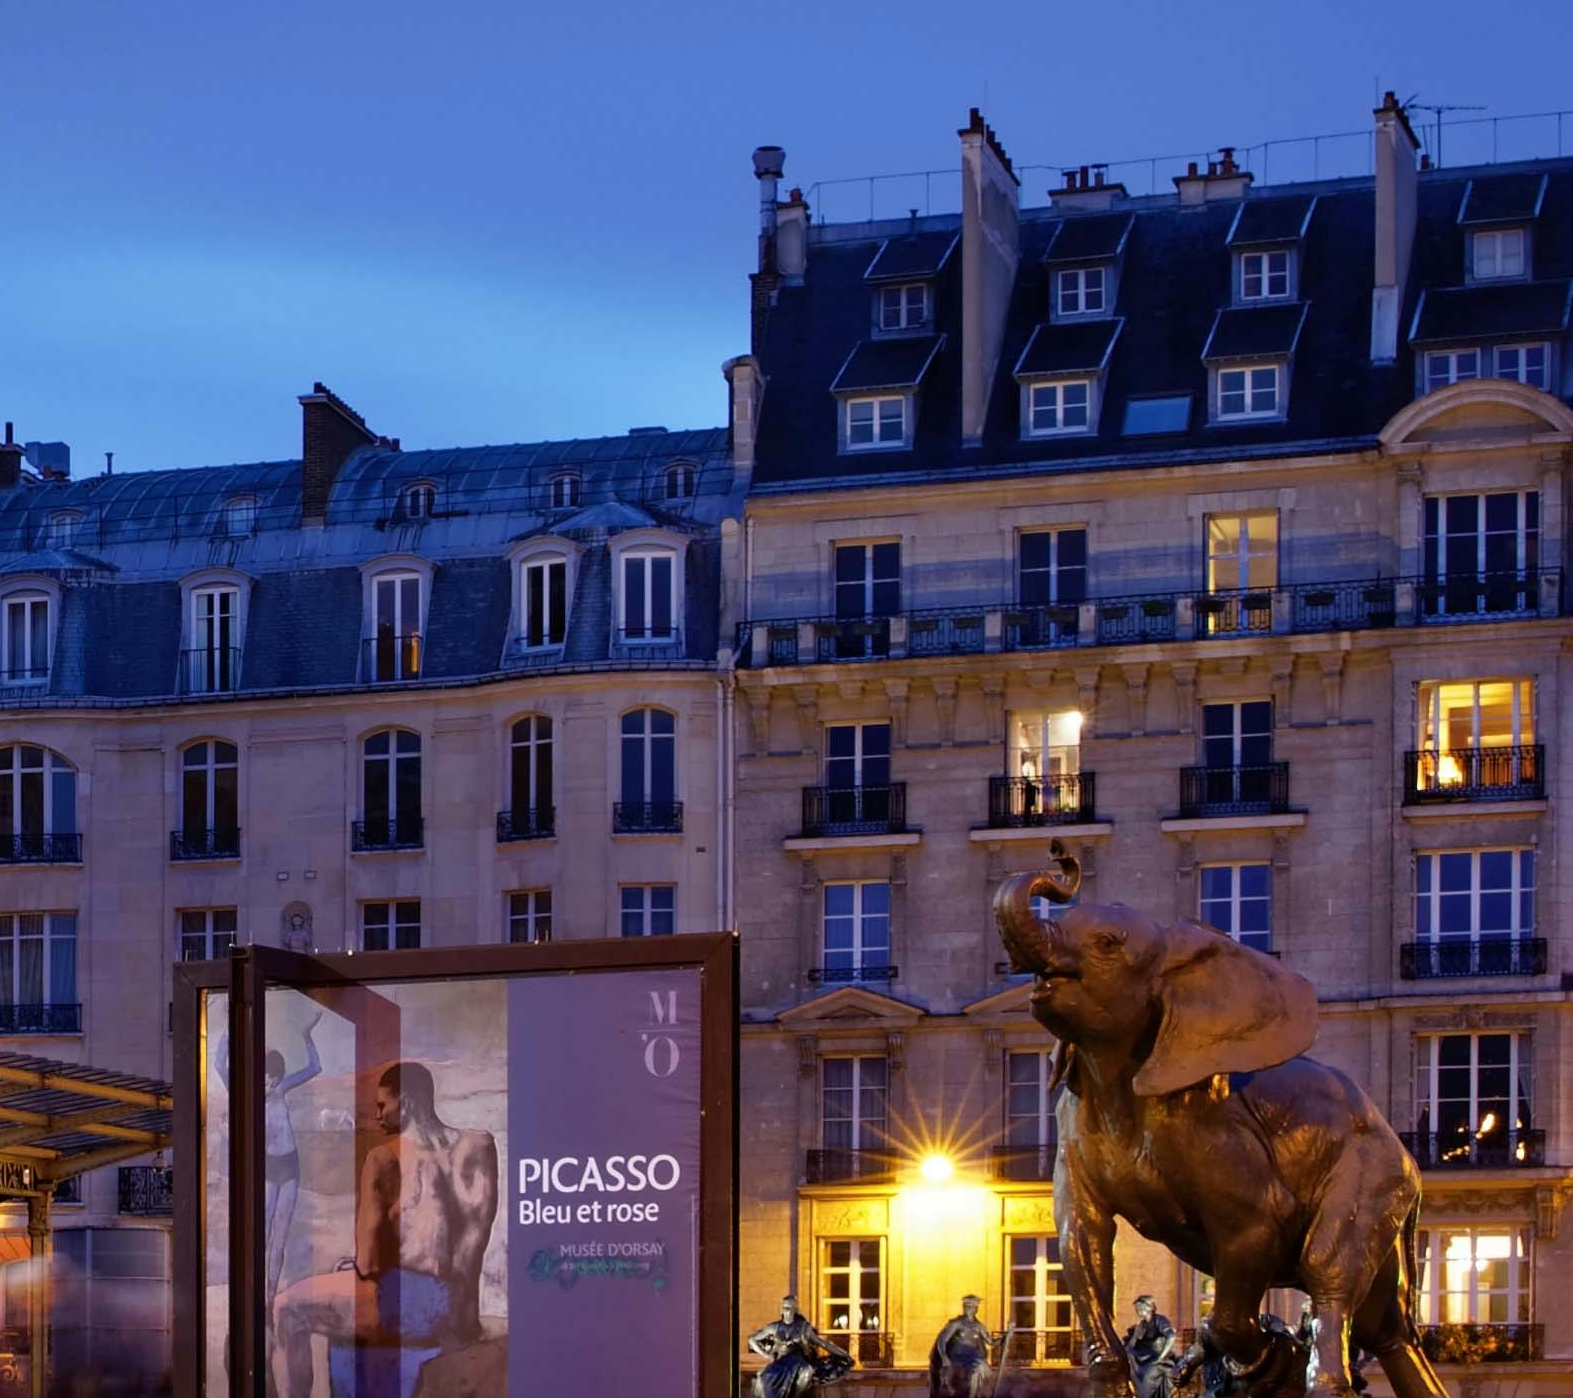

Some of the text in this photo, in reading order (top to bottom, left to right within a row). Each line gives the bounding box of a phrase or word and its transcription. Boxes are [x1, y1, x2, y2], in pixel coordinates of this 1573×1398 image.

[648, 990, 678, 1026] M
[518, 1153, 681, 1195] PICASSO
[518, 1198, 660, 1225] Bleu et rose
[559, 1240, 666, 1258] MUSÉE D'ORSAY
